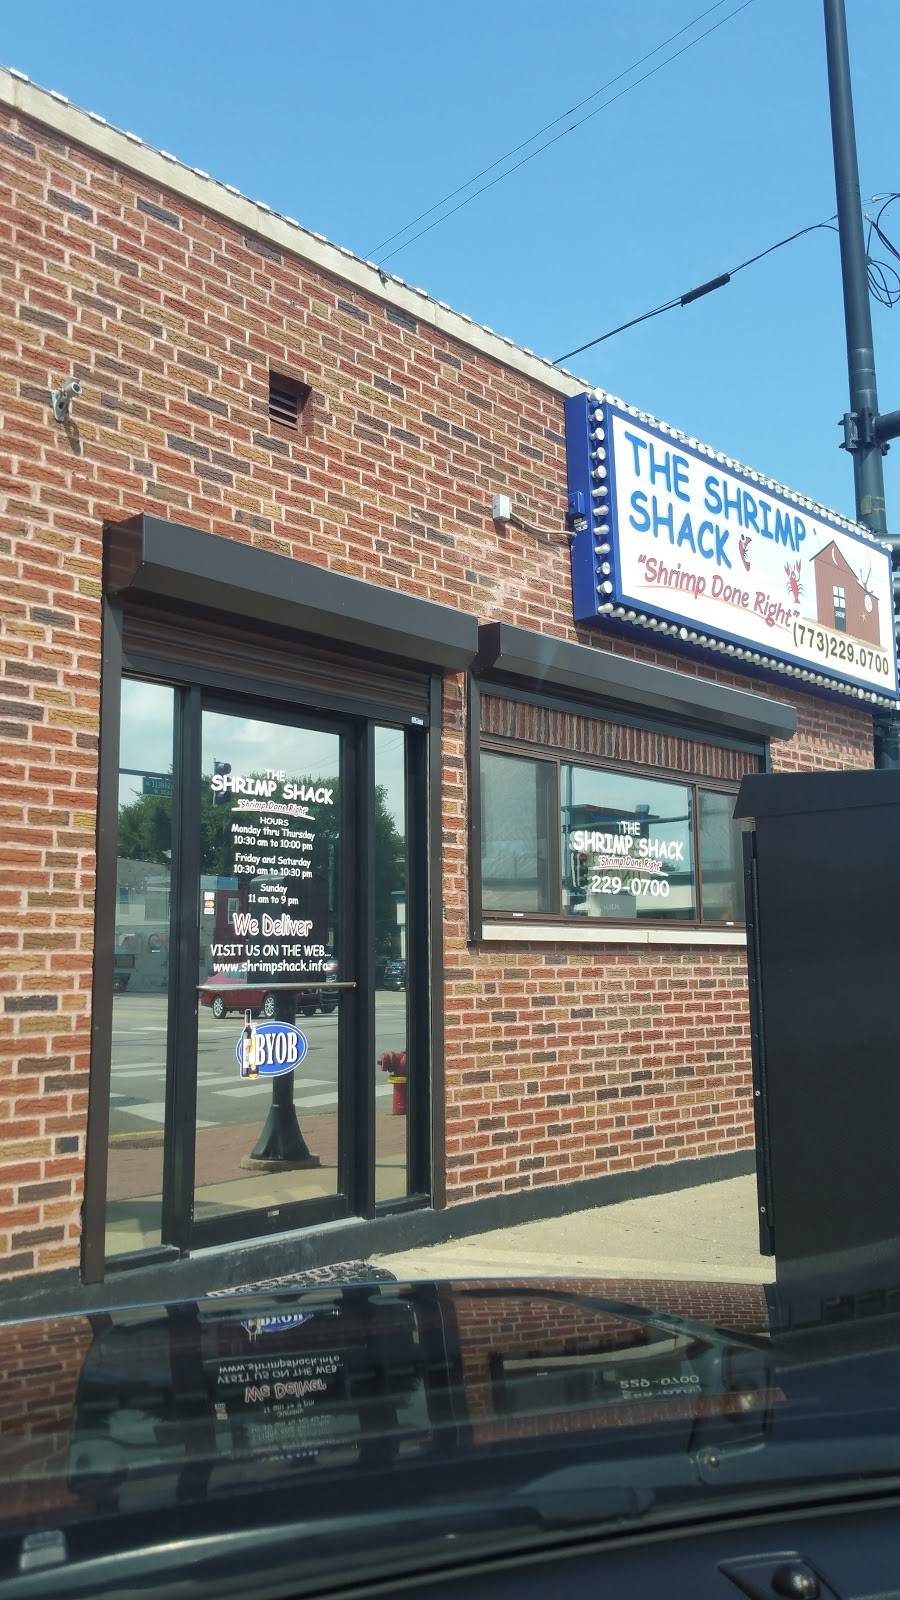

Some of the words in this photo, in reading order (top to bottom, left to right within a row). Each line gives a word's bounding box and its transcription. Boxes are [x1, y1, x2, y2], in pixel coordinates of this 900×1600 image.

[625, 431, 690, 502] THE
[704, 475, 806, 552] SHRIMP
[629, 490, 732, 569] SHACK
[712, 575, 749, 608] Done
[792, 621, 889, 676] (773)229.0700
[265, 768, 286, 782] THE
[211, 775, 277, 798] SHRIMP
[282, 784, 334, 804] SHACK
[268, 801, 288, 812] Done
[259, 817, 289, 827] HOURS
[620, 821, 640, 835] THE
[231, 824, 262, 837] Monday
[263, 827, 280, 838] thru
[281, 828, 315, 841] Thursday
[233, 836, 255, 846] 10:30
[257, 839, 268, 847] am
[270, 838, 278, 848] to
[280, 839, 301, 850] 10:00
[302, 842, 313, 853] pm
[573, 831, 633, 855] SHRIMP
[639, 839, 685, 861] SHACK
[235, 853, 260, 865] Friday
[262, 855, 276, 865] and
[278, 856, 311, 868] Saturday
[625, 856, 643, 868] Done
[233, 865, 255, 874] 10:30
[257, 867, 268, 875] am
[270, 867, 278, 876] to
[280, 868, 301, 878] 10:30
[302, 870, 313, 880] pm
[260, 883, 288, 895] Sunday
[591, 875, 669, 897] 229-0700
[248, 894, 256, 903] 11
[258, 896, 269, 904] am
[271, 895, 279, 905] to
[280, 895, 287, 905] 9
[288, 897, 299, 907] pm
[233, 913, 259, 936] We
[262, 914, 313, 937] Deliver
[210, 944, 243, 956] VISIT
[246, 945, 261, 956] US
[263, 945, 278, 957] ON
[281, 945, 302, 957] THE
[303, 945, 332, 958] WEB...
[213, 960, 329, 974] www.shrimpshack.info
[255, 1032, 298, 1065] BYOB
